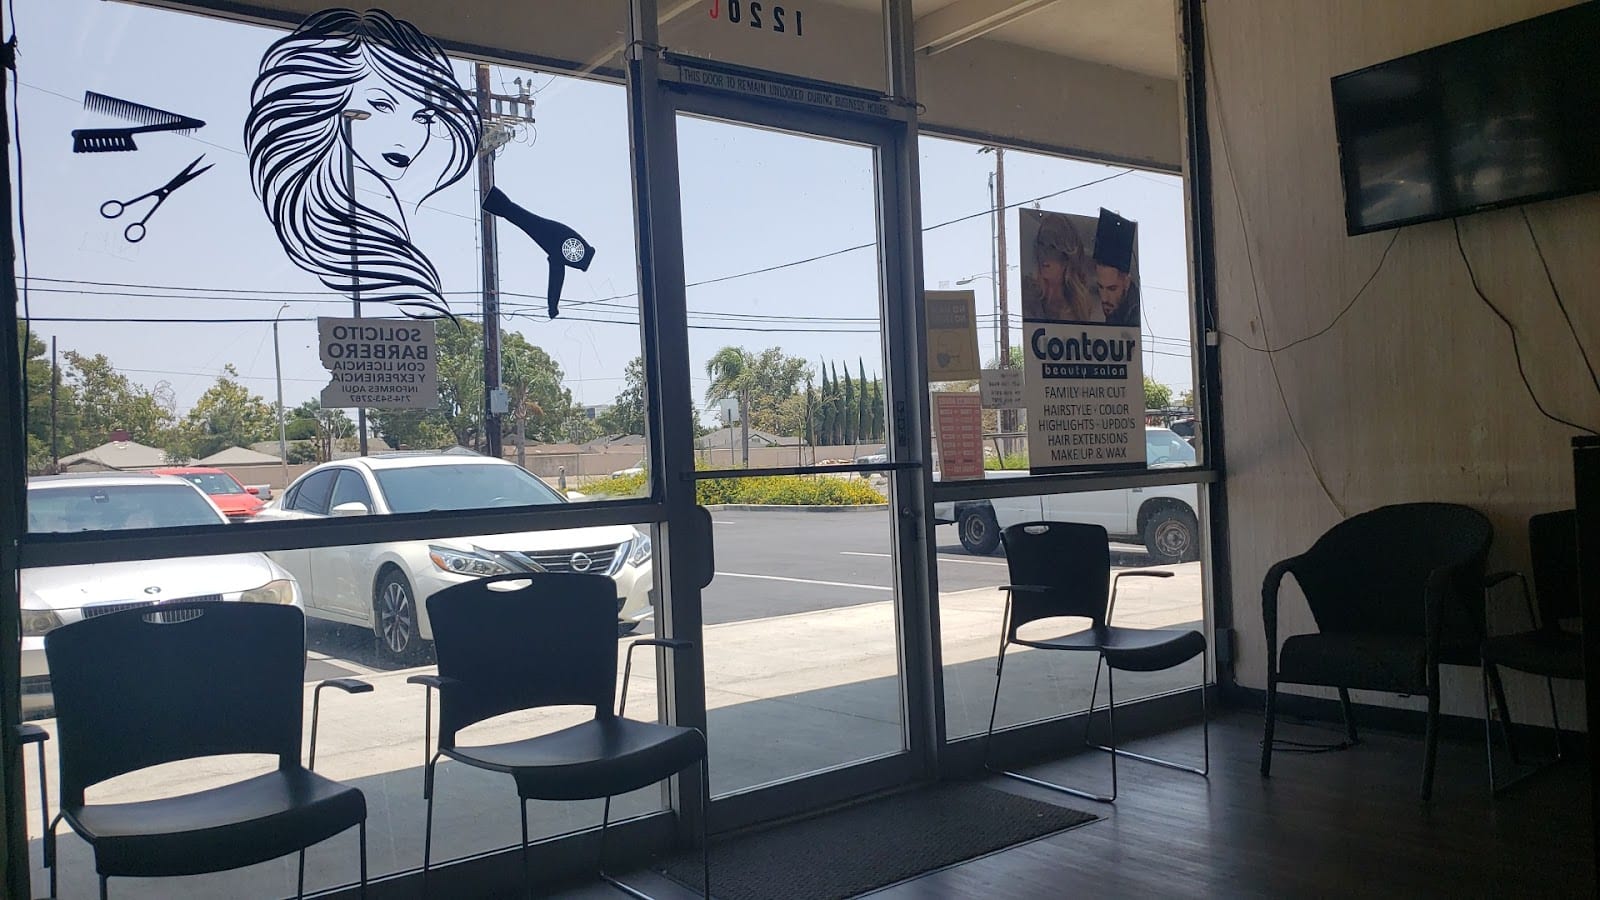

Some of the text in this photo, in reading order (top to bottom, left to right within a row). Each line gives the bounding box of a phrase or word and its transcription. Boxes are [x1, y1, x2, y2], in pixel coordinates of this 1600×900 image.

[684, 69, 701, 82] THIS
[702, 74, 724, 87] DOOR
[727, 79, 736, 89] TO
[738, 81, 767, 95] REMAIN
[769, 84, 804, 100] UNLOCKED
[807, 92, 833, 106] DURING
[1031, 327, 1136, 362] Contour
[1044, 364, 1126, 379] beauty salon
[1045, 386, 1126, 399] FAMILY HAIR CUT
[1043, 403, 1130, 417] HAIRSTYLE COLOR
[1038, 417, 1136, 432] HIGHLIGHTS UPDO'S
[1047, 432, 1128, 447] HAIR EXTENSIONS
[1051, 447, 1127, 462] MAKE UP & WAX
